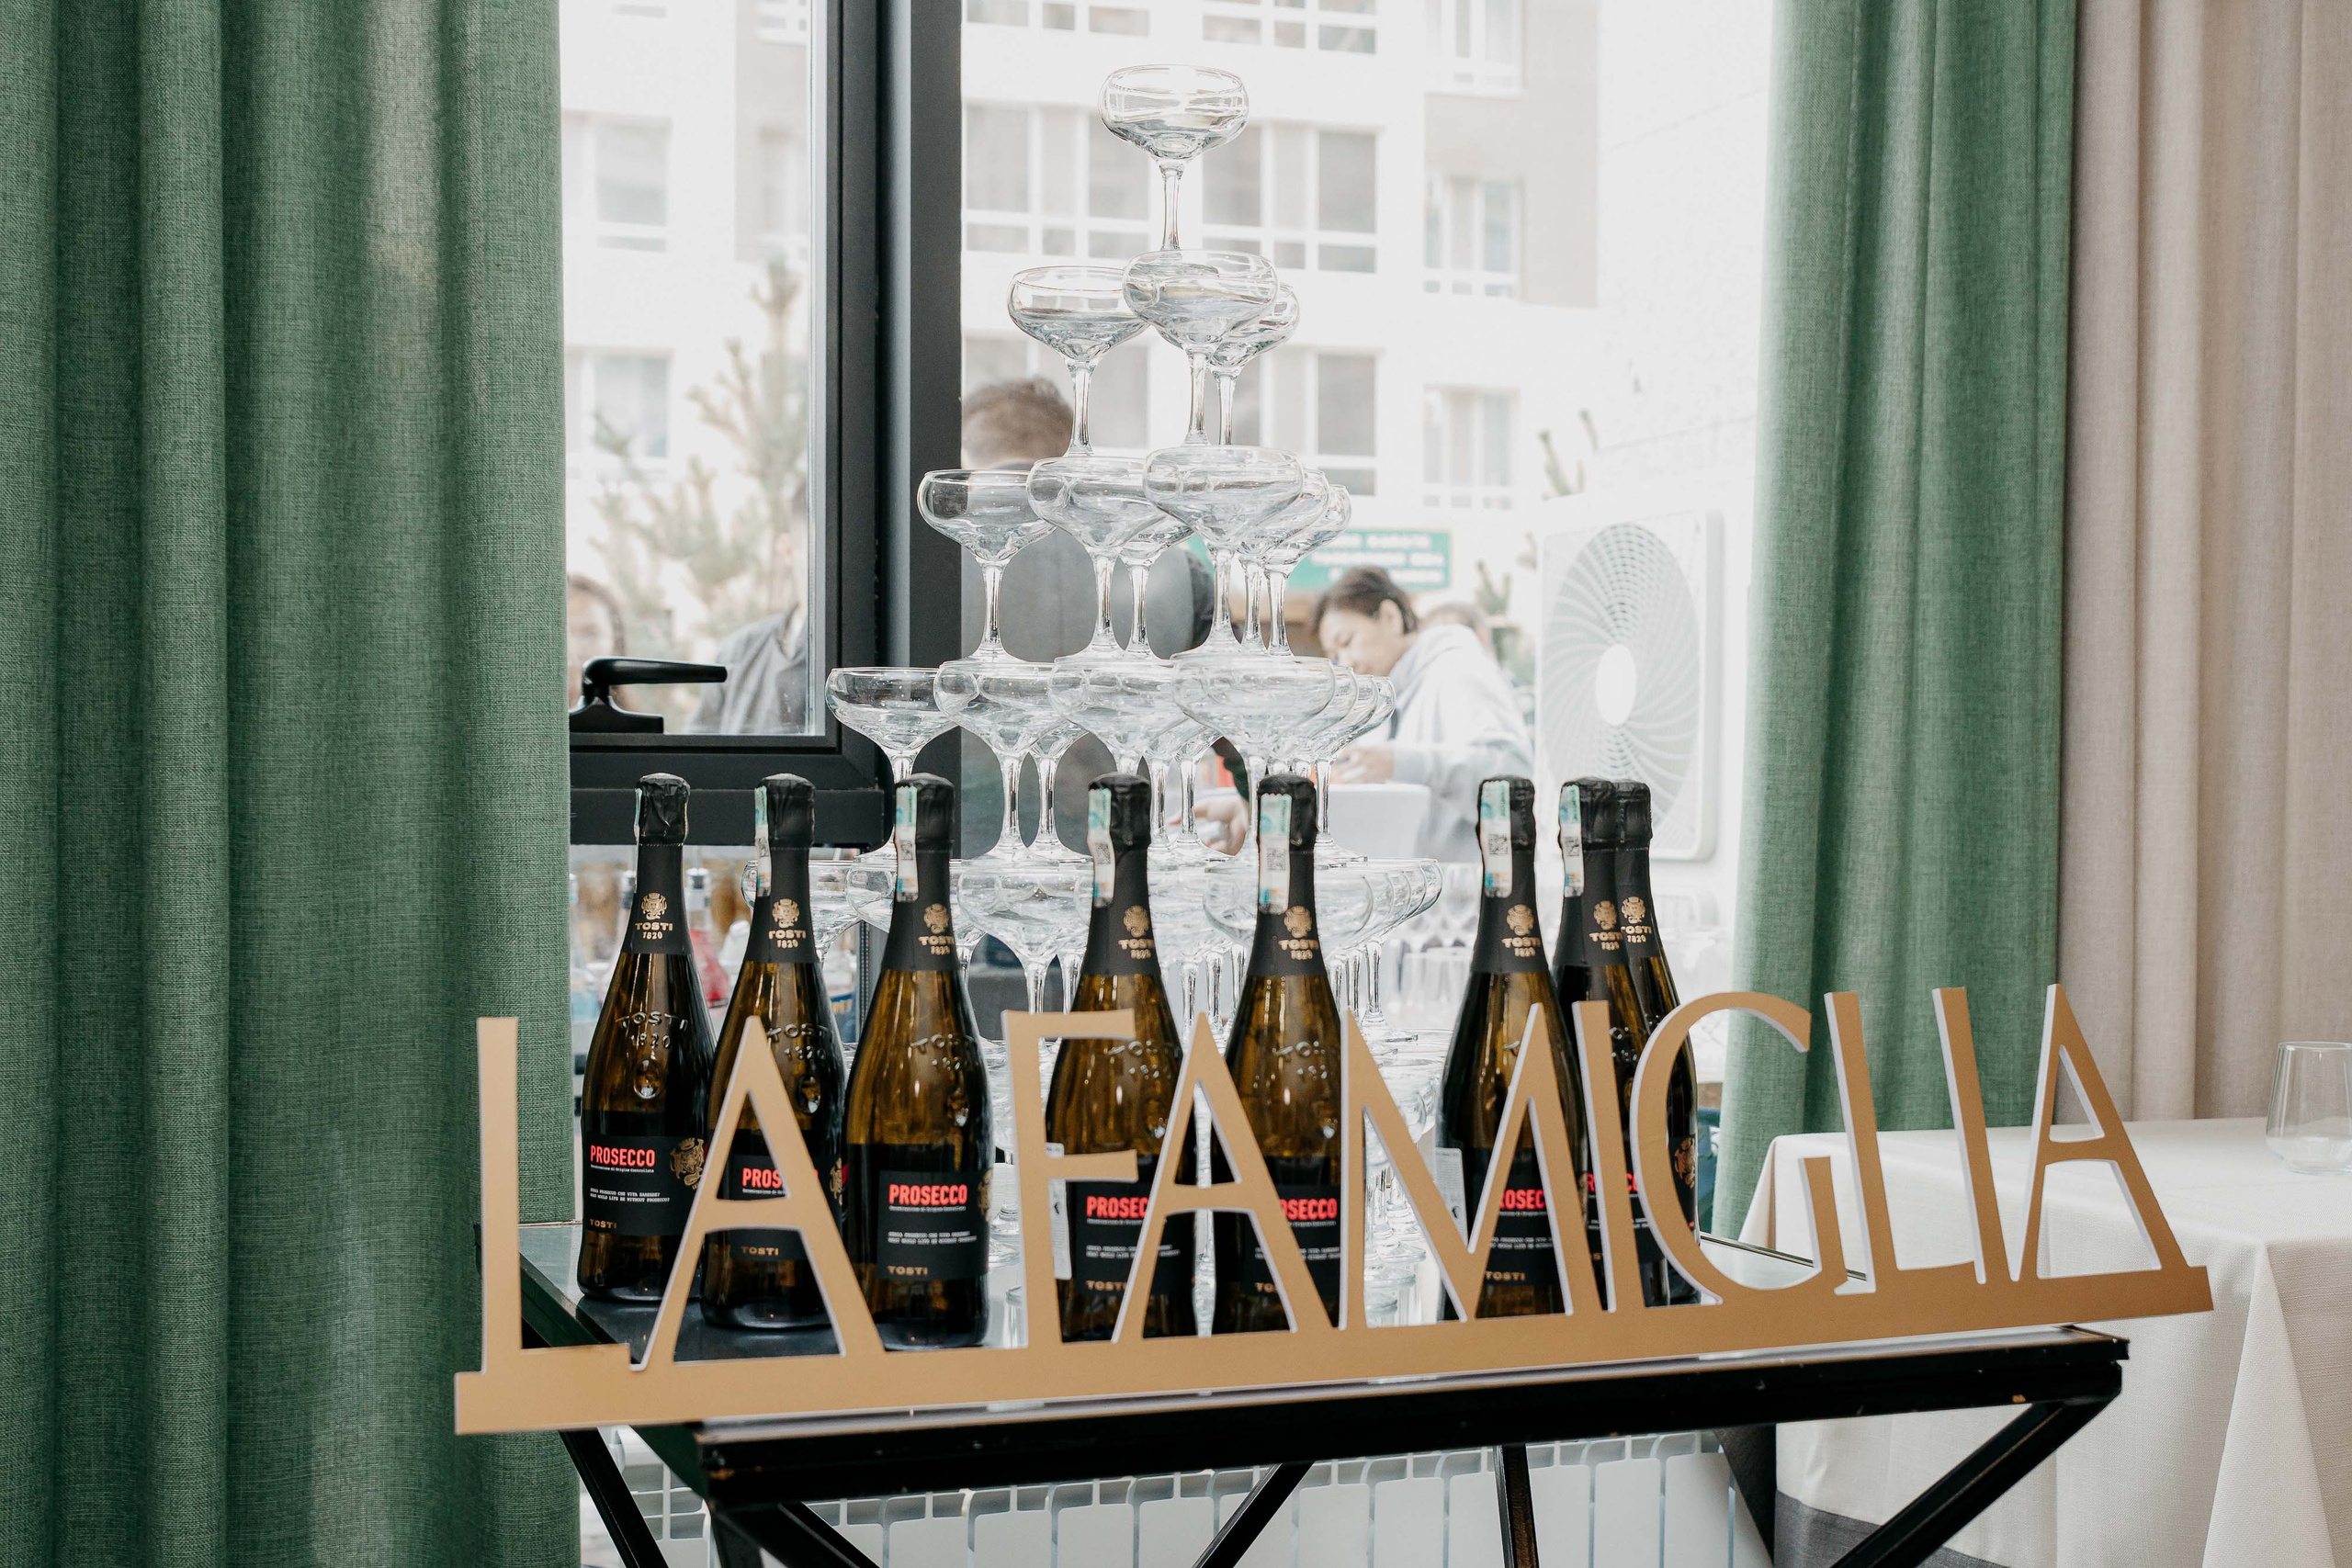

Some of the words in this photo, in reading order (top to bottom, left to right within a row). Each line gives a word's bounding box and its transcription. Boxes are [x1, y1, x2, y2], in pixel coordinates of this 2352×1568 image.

[635, 922, 673, 931] TOSTI
[643, 931, 663, 940] 1820
[768, 930, 807, 939] TOSTI
[615, 1011, 689, 1031] TOSTI
[590, 1145, 656, 1168] PROSECCO
[475, 1015, 887, 1374] LA
[1002, 984, 2192, 1350] FAMIGLIA
[889, 1183, 967, 1206] PROSECCO
[1086, 1195, 1149, 1219] PROSEC
[589, 1218, 617, 1229] TOSTI
[741, 1247, 779, 1257] TOSTI
[887, 1265, 928, 1276] TOSTI
